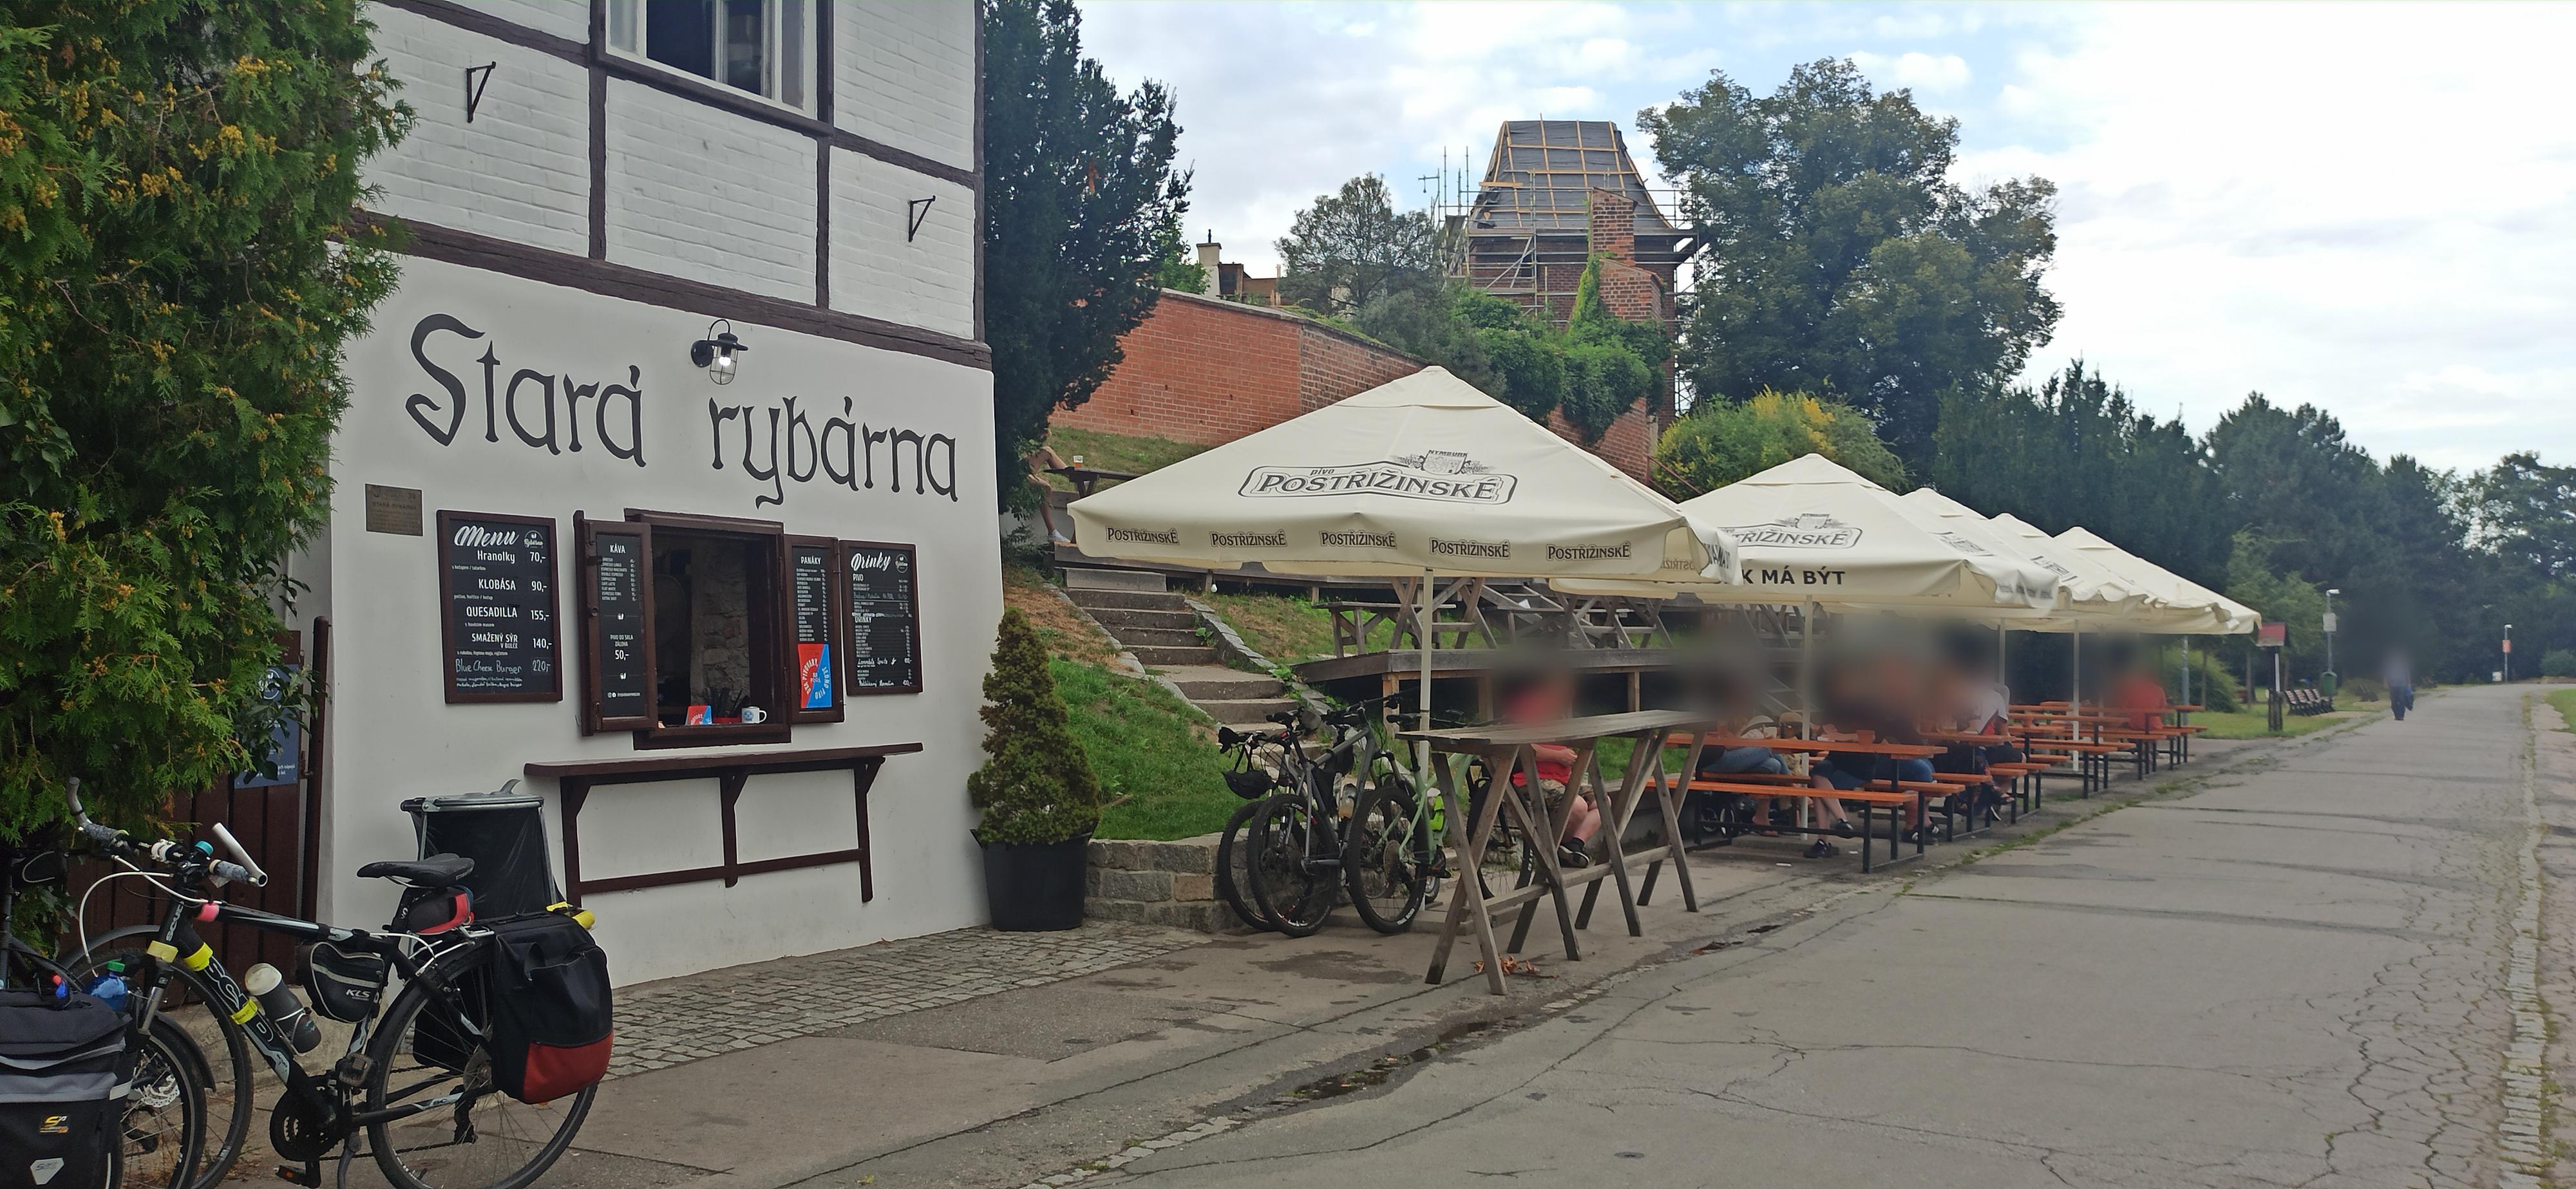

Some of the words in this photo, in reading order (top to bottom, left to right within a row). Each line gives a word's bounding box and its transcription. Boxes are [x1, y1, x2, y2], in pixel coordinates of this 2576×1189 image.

[405, 313, 647, 467] Stará
[710, 395, 959, 510] rybárna
[1310, 468, 1335, 476] pivo
[1257, 469, 1497, 500] POSTŘIŽINSKÉ
[454, 525, 520, 547] Menu
[1106, 526, 1179, 545] POSTŘIŽINSKÉ
[1211, 530, 1286, 547] POSTŘIŽINSKÉ
[1321, 530, 1396, 548] POSTŘIŽINSKÉ
[1732, 529, 1848, 546] TŘIŽINSKÉ
[610, 543, 626, 554] KÁVA
[1431, 539, 1510, 558] POSTŘIŽINSKÉ
[1547, 541, 1630, 560] POSTŘIŽINSKÉ
[477, 550, 515, 564] Hranolky
[529, 552, 546, 563] 70,-
[800, 555, 821, 565] PANÁKY
[851, 551, 891, 572] Drinky
[1761, 566, 1795, 585] MÁ
[1803, 566, 1846, 585] BÝT
[478, 577, 516, 590] KLOBÁSA
[531, 581, 547, 592] 90,-
[466, 606, 518, 618] QUESADILLA
[531, 610, 549, 621] 155,-
[471, 632, 504, 642] SMAŽENÝ
[505, 633, 518, 643] SÝR
[533, 638, 552, 650] 140,-
[614, 650, 629, 661] 50,-
[455, 659, 472, 673] Blue
[496, 660, 522, 674] Burger
[346, 989, 371, 998] KLS
